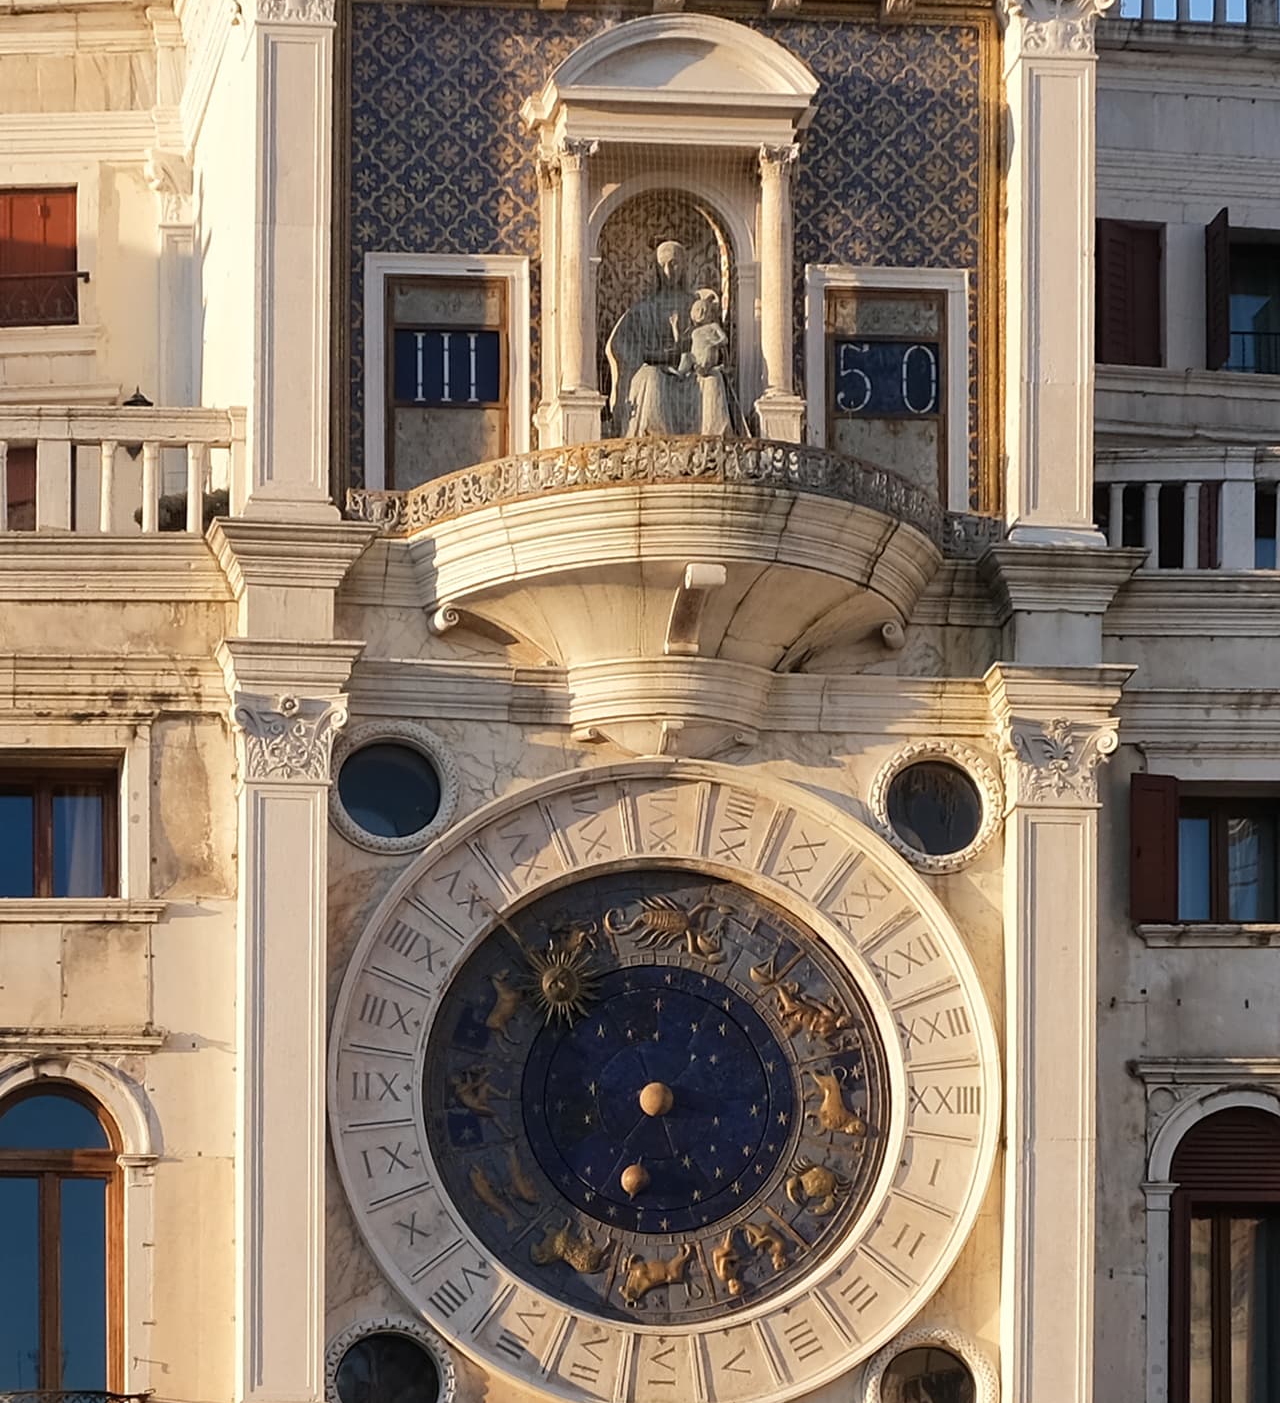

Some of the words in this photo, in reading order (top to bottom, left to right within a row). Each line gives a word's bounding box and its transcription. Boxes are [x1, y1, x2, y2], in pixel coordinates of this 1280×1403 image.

[413, 332, 480, 403] III
[393, 1210, 432, 1247] X
[720, 1348, 752, 1375] V
